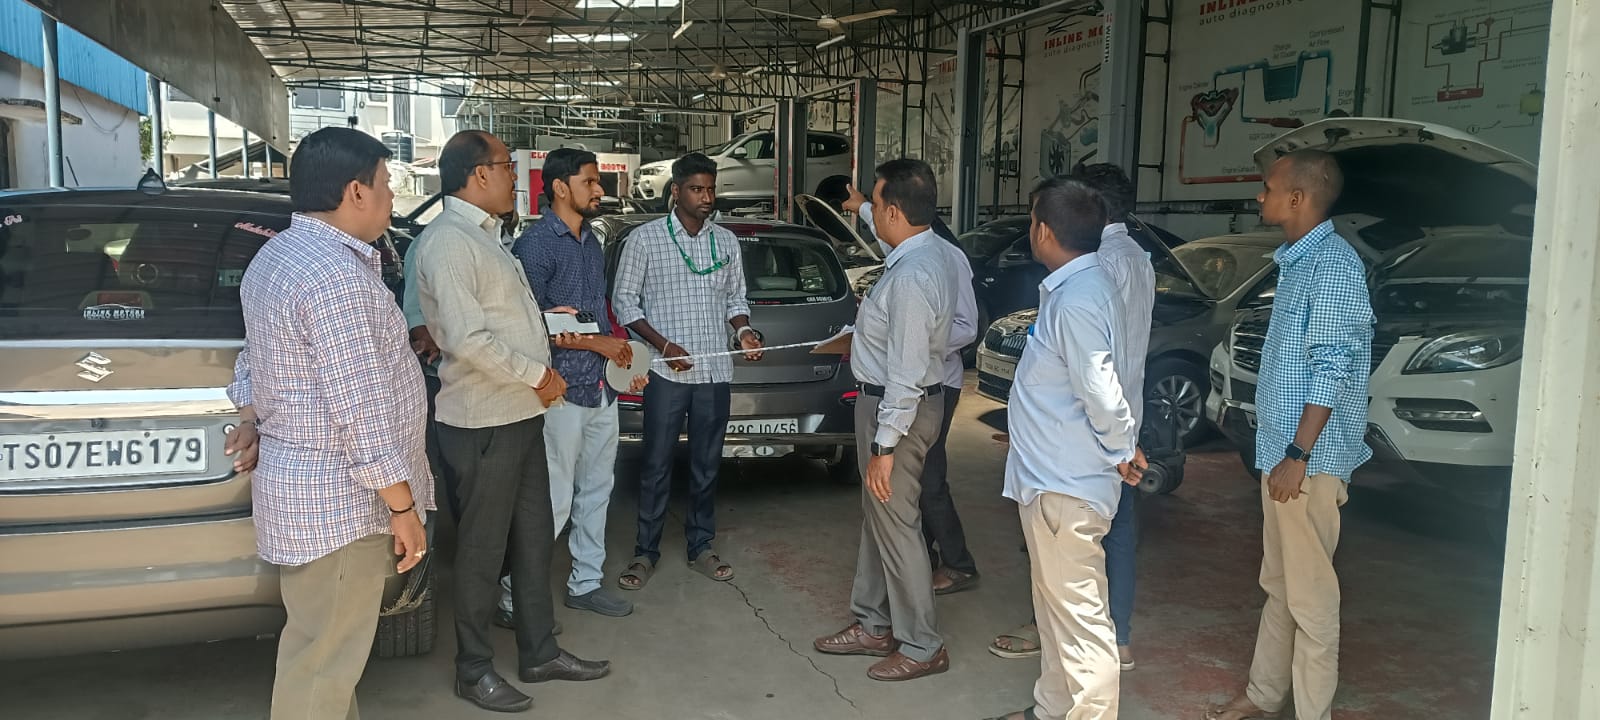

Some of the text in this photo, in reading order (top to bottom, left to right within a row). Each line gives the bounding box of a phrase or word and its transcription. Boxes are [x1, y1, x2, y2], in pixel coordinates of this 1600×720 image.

[1200, 14, 1225, 26] auto
[1044, 32, 1082, 50] INLINE
[3, 437, 201, 470] TS07EW6179
